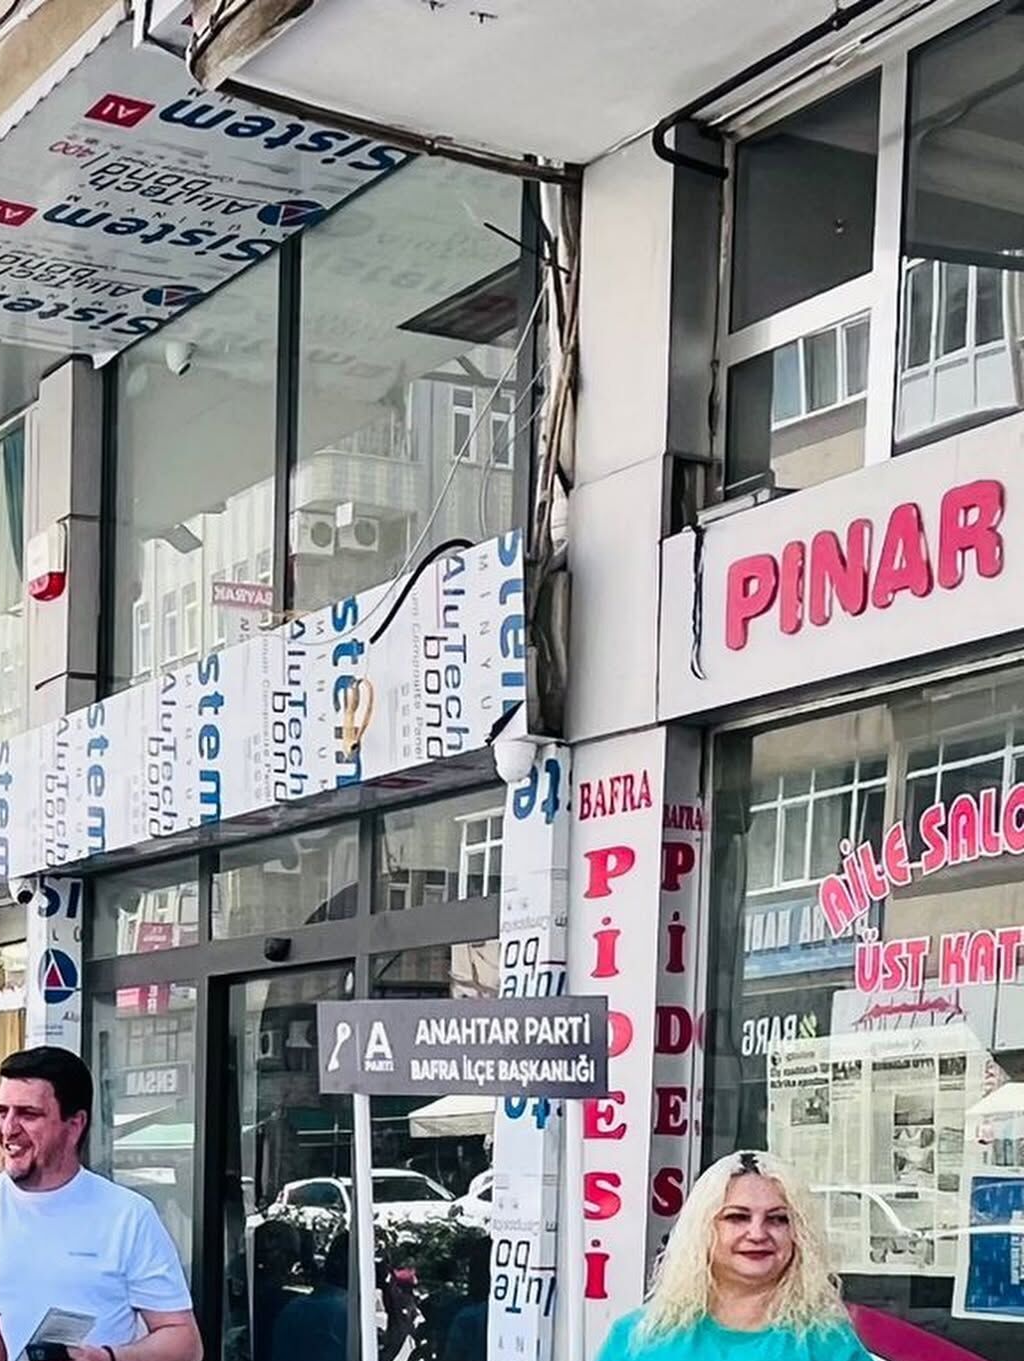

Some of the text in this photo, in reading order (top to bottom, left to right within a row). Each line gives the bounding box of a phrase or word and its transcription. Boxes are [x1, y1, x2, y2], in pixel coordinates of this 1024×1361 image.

[43, 203, 280, 262] Sistem
[724, 480, 1007, 651] PINAR
[287, 619, 308, 796] AluTech
[424, 634, 448, 760] bond
[443, 555, 469, 751] AluTech
[56, 716, 70, 862] AluTech
[87, 701, 109, 856] stem
[148, 736, 164, 838] bond
[161, 672, 178, 832] AluTech
[198, 653, 224, 826] stem
[272, 690, 292, 801] bond
[578, 768, 654, 822] BAFRA
[855, 926, 931, 994] ÜST
[939, 926, 1024, 988] KAT
[364, 1021, 393, 1059] A
[411, 1055, 595, 1087] BAFRA İLÇE BAŞKANLIĞI
[414, 1013, 591, 1045] ANAHTAR PARTİ
[651, 841, 697, 1218] PİDES
